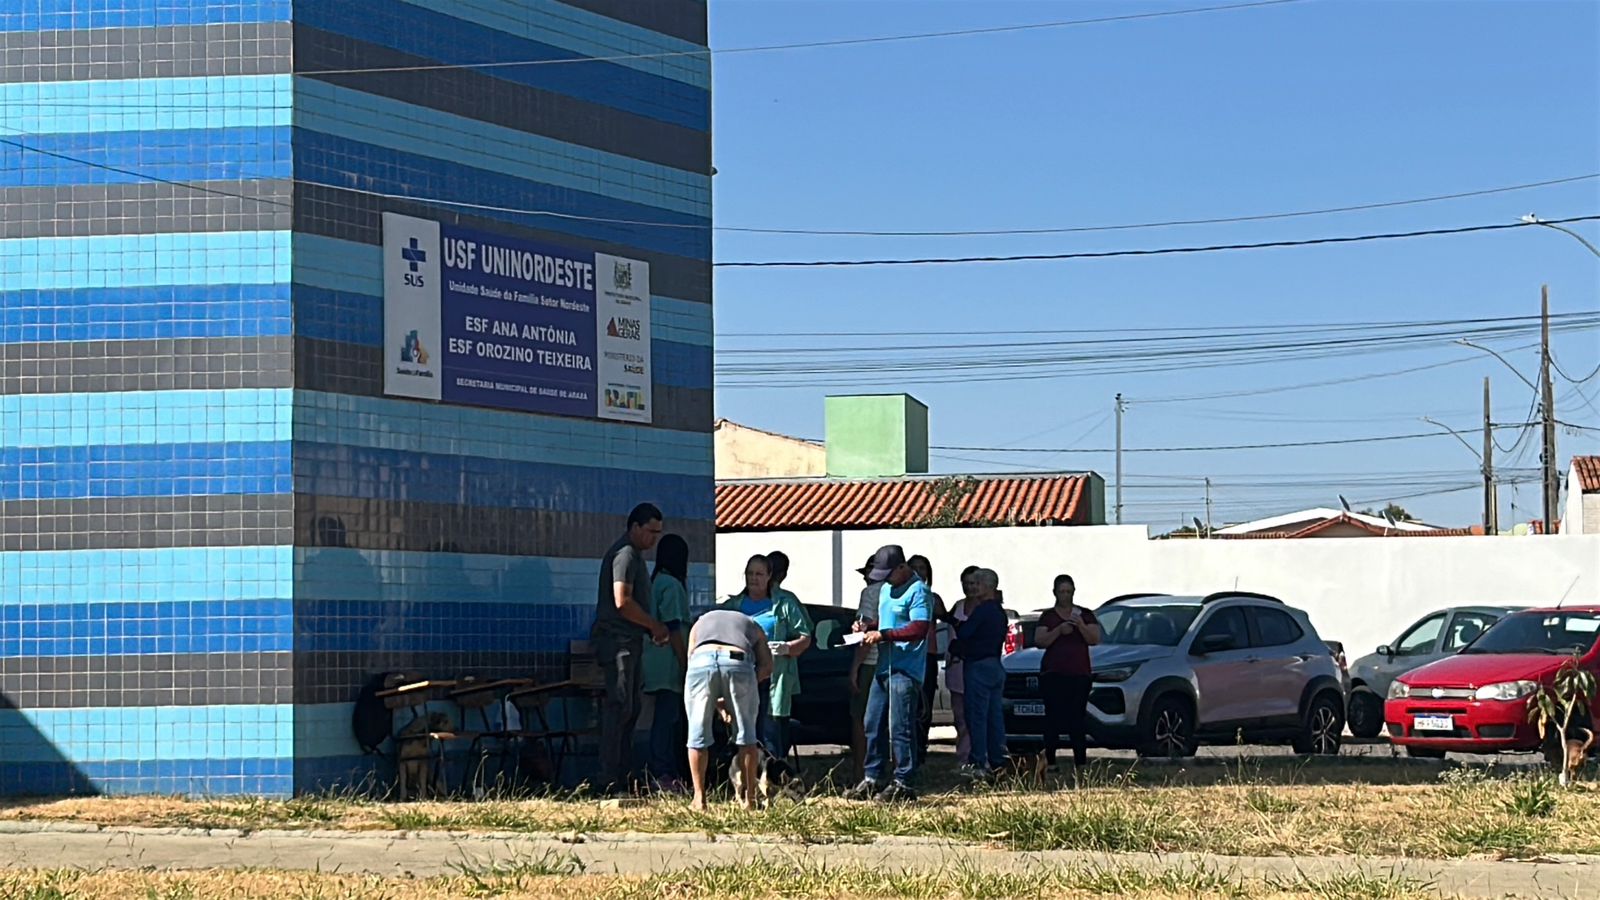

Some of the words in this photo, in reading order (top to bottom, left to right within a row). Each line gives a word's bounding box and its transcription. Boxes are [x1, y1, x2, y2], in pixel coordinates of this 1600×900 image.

[444, 237, 477, 270] USF
[482, 244, 593, 291] UNINORDESTE
[403, 273, 425, 288] SUS
[449, 280, 479, 296] Unidade
[503, 290, 513, 301] da
[540, 295, 559, 307] Setor
[560, 298, 590, 313] Nordeste
[465, 316, 489, 333] ESF
[492, 321, 519, 338] ANA
[618, 317, 640, 331] MINAS
[618, 327, 640, 341] GERAIS
[449, 338, 473, 355] ESF
[477, 342, 533, 363] OROZINO
[537, 349, 592, 371] TEIXEIRA
[456, 377, 494, 389] SECRETARIA
[495, 382, 528, 393] MUNICIPAL
[529, 386, 537, 395] DE
[559, 390, 567, 398] DE
